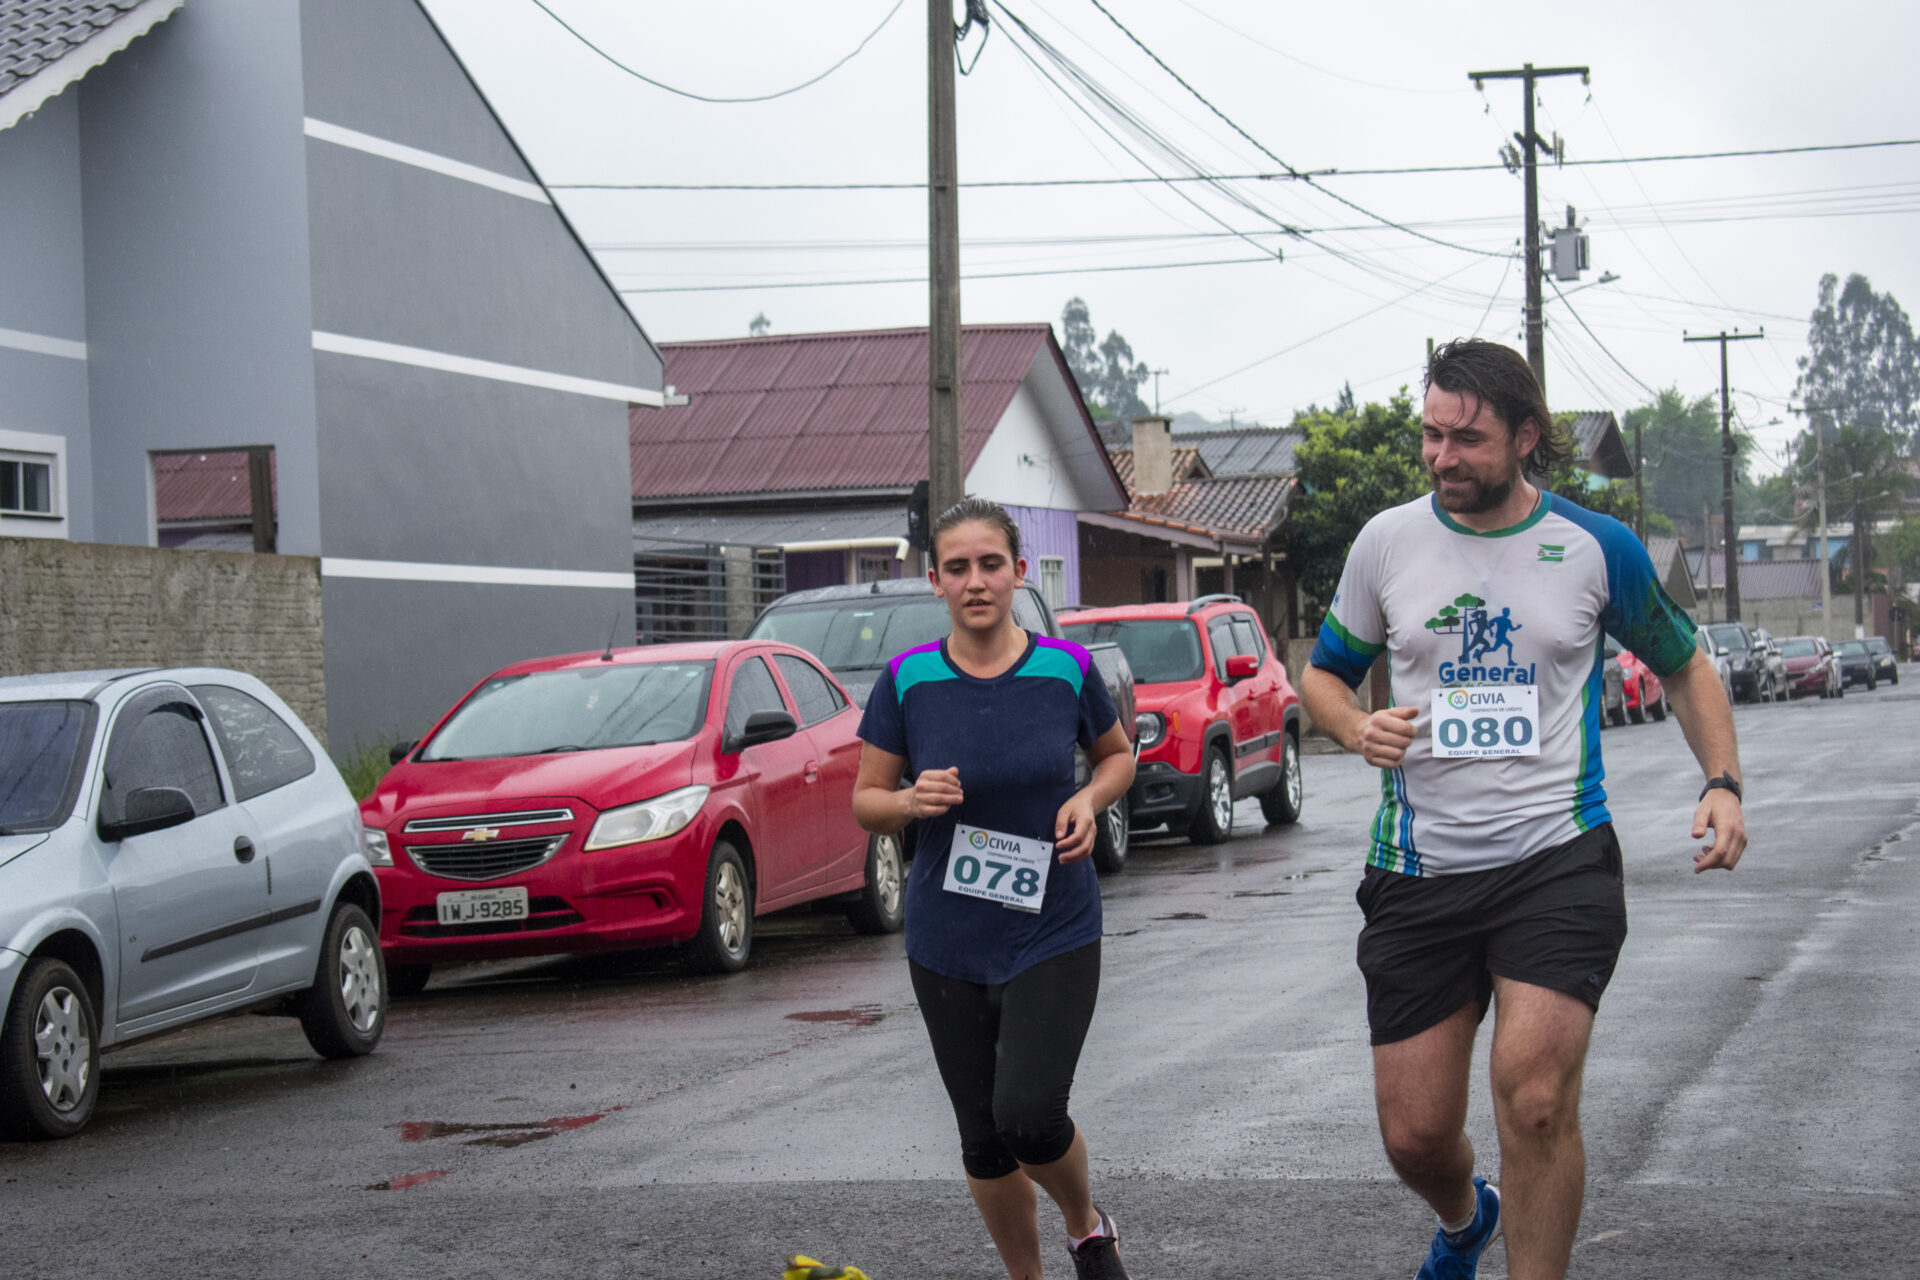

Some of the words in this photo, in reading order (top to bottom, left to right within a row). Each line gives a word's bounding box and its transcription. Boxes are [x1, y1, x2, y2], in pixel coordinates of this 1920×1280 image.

[1438, 661, 1536, 684] General
[1470, 692, 1505, 705] CIVIA
[1438, 716, 1533, 748] 080
[988, 836, 1021, 854] CIVIA
[953, 855, 1040, 897] 078
[958, 885, 987, 897] EQUIPE
[988, 892, 1025, 904] GENERAL
